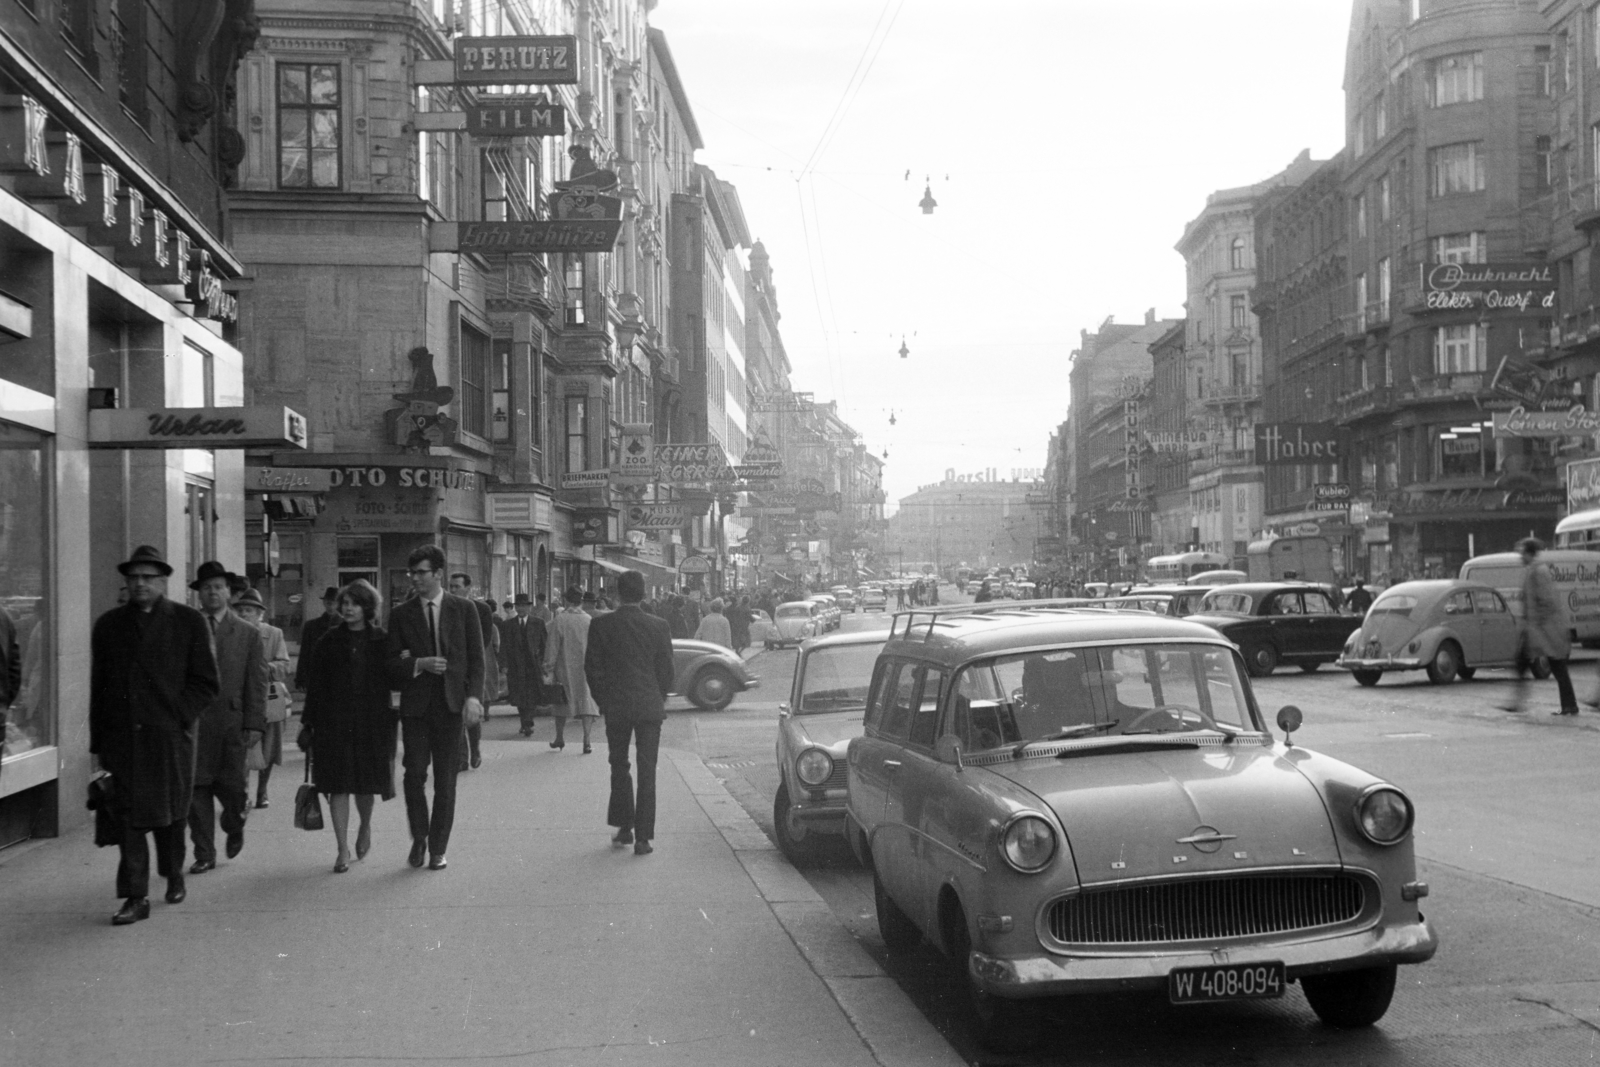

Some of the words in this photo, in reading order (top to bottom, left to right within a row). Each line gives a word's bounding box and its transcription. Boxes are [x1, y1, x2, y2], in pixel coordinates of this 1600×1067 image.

[463, 46, 568, 71] PERUTZ
[480, 109, 552, 129] FILM
[1440, 266, 1553, 282] Bauknecht
[148, 412, 246, 437] Urban
[1127, 402, 1139, 499] HUMANIC
[1259, 425, 1338, 461] Haber
[625, 456, 647, 464] ZOO
[330, 467, 386, 487] OTO
[562, 472, 609, 482] BRIEFMARKEN
[650, 506, 682, 514] MUSIK
[1110, 849, 1307, 870] OPEL
[1175, 971, 1195, 999] W
